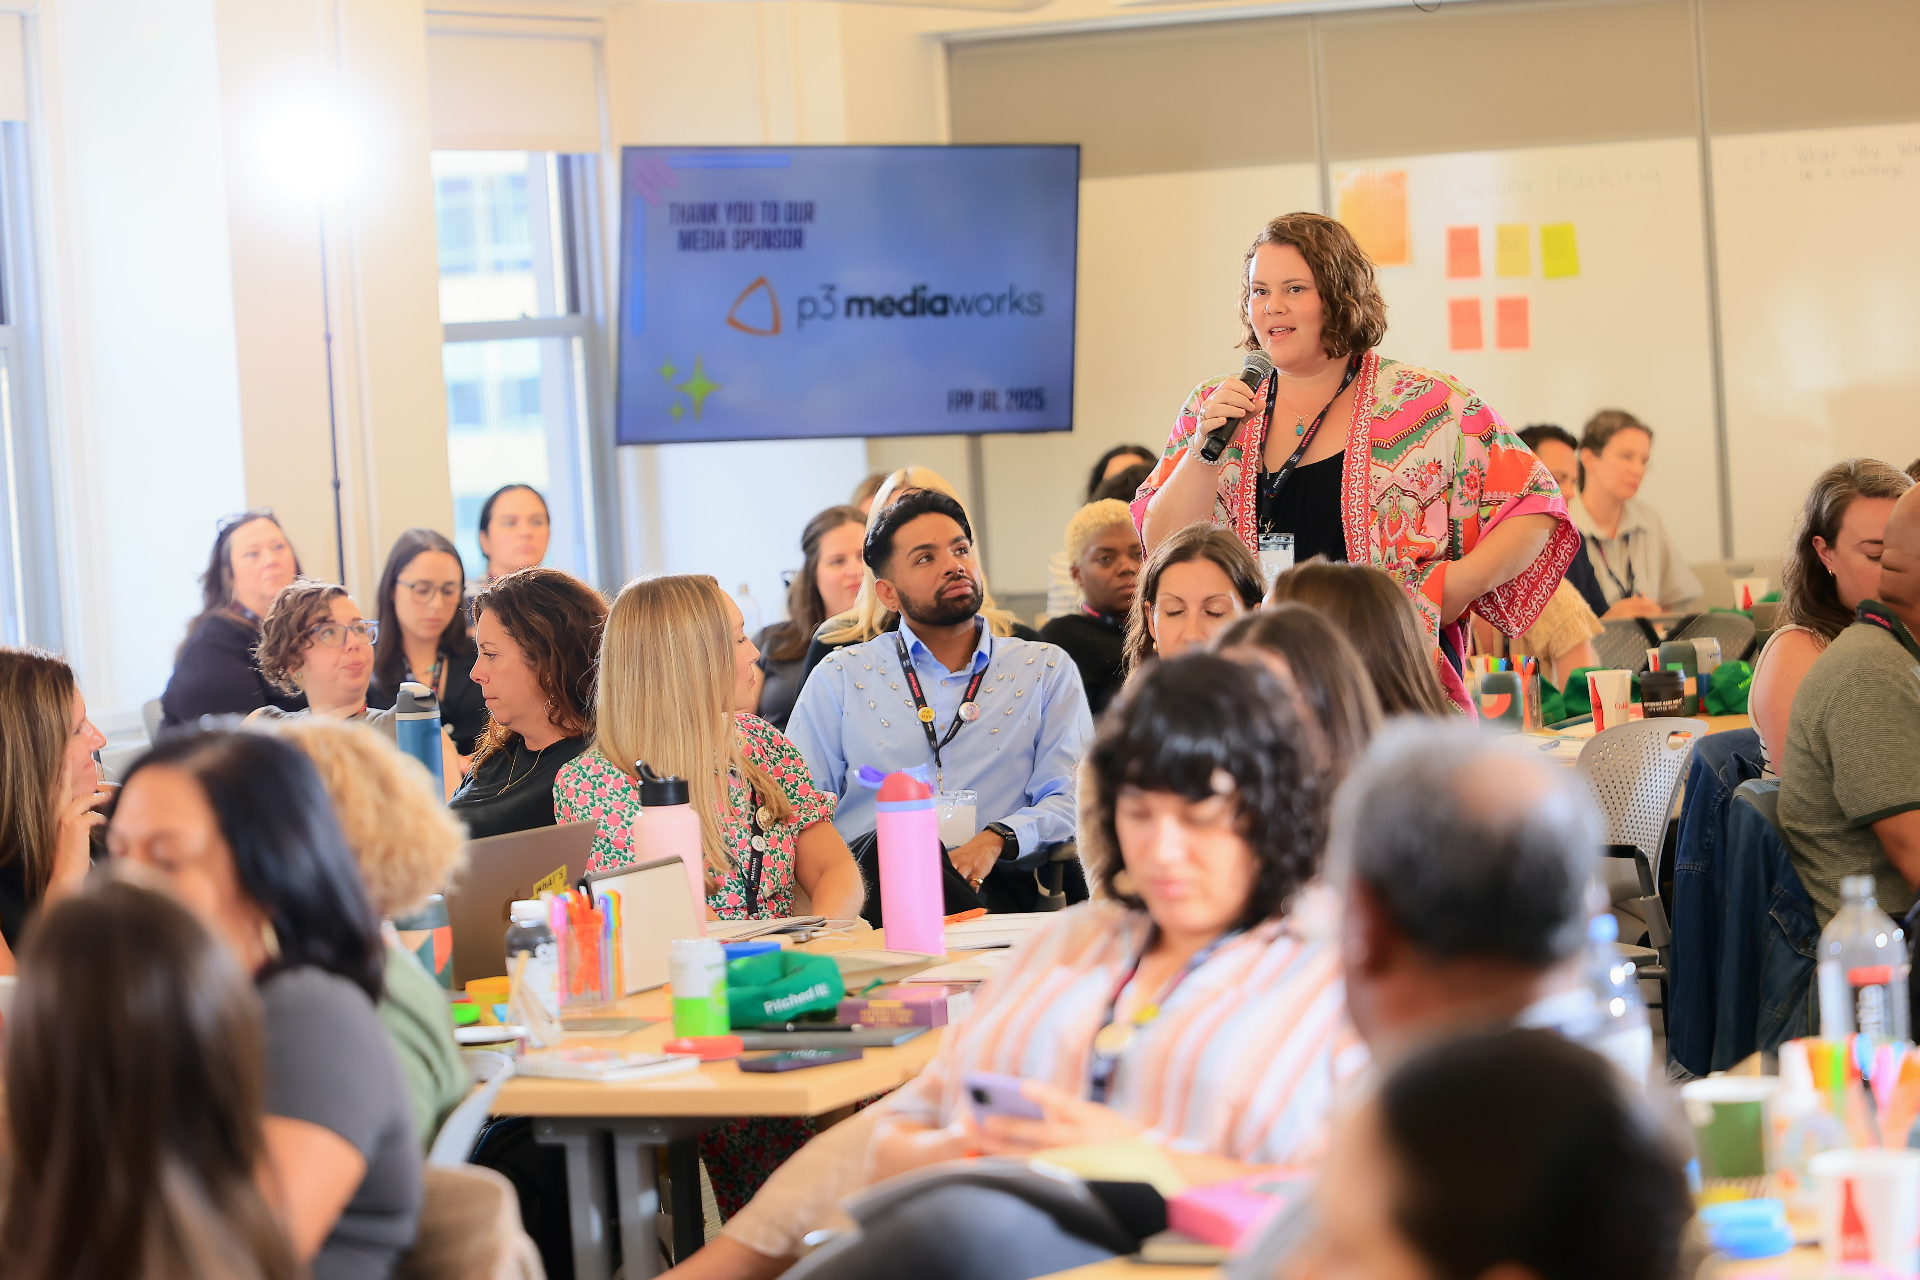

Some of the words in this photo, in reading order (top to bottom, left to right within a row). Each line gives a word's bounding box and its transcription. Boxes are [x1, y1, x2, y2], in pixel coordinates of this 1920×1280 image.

[1556, 160, 1662, 196] Parking
[669, 201, 718, 224] THANK
[724, 201, 754, 224] YOU
[761, 201, 778, 223] TO
[785, 201, 814, 223] OUR
[678, 229, 726, 251] MEDIA
[732, 228, 803, 250] SPONSOR
[797, 283, 836, 329] p3
[844, 284, 1043, 318] mediaworks
[1005, 387, 1044, 412] 2025
